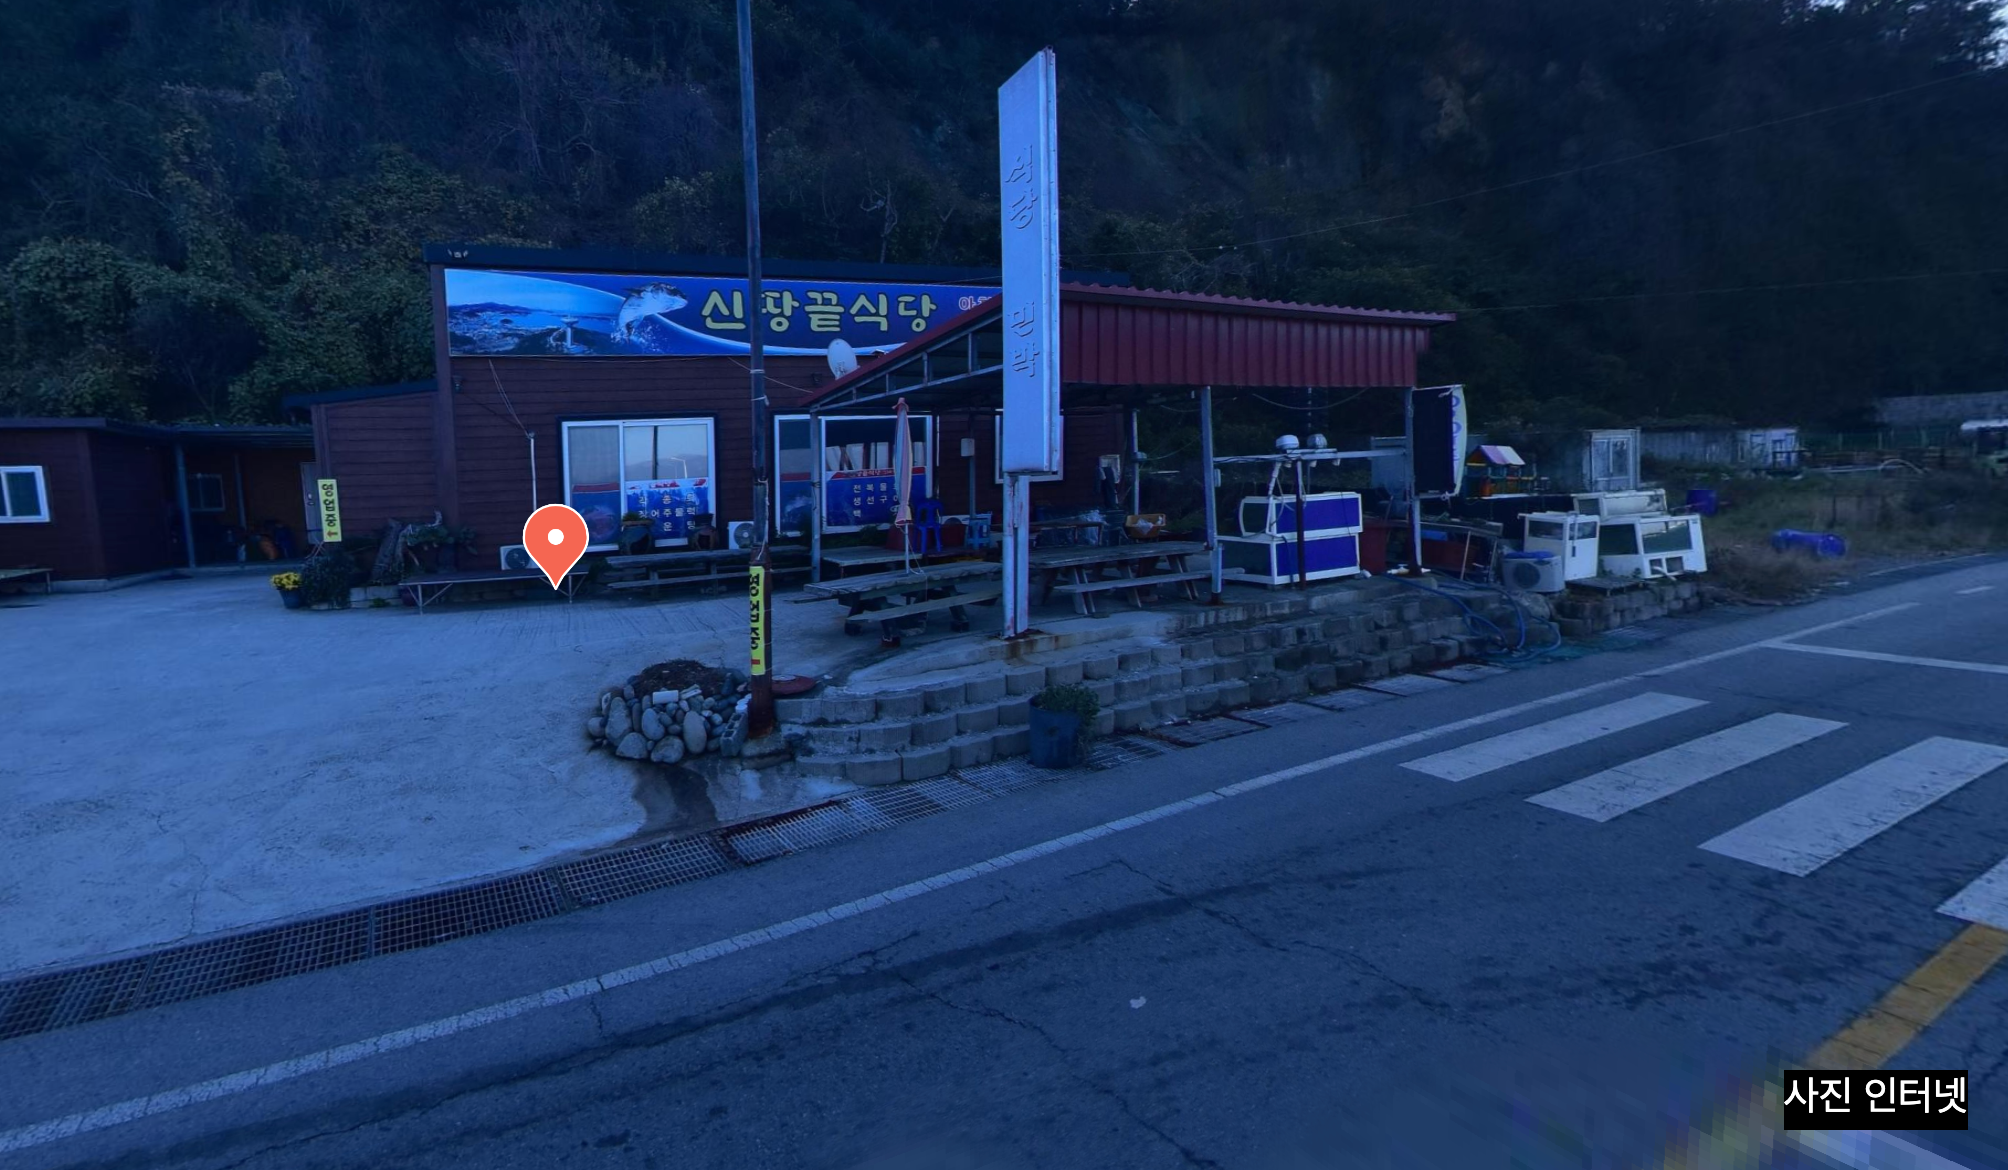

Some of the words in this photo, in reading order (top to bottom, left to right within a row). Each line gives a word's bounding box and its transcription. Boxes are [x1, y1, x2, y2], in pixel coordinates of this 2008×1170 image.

[1005, 144, 1038, 229] 식당
[701, 289, 937, 332] 신땅끝식당
[1008, 301, 1040, 378] 민박
[322, 483, 337, 527] 영업중
